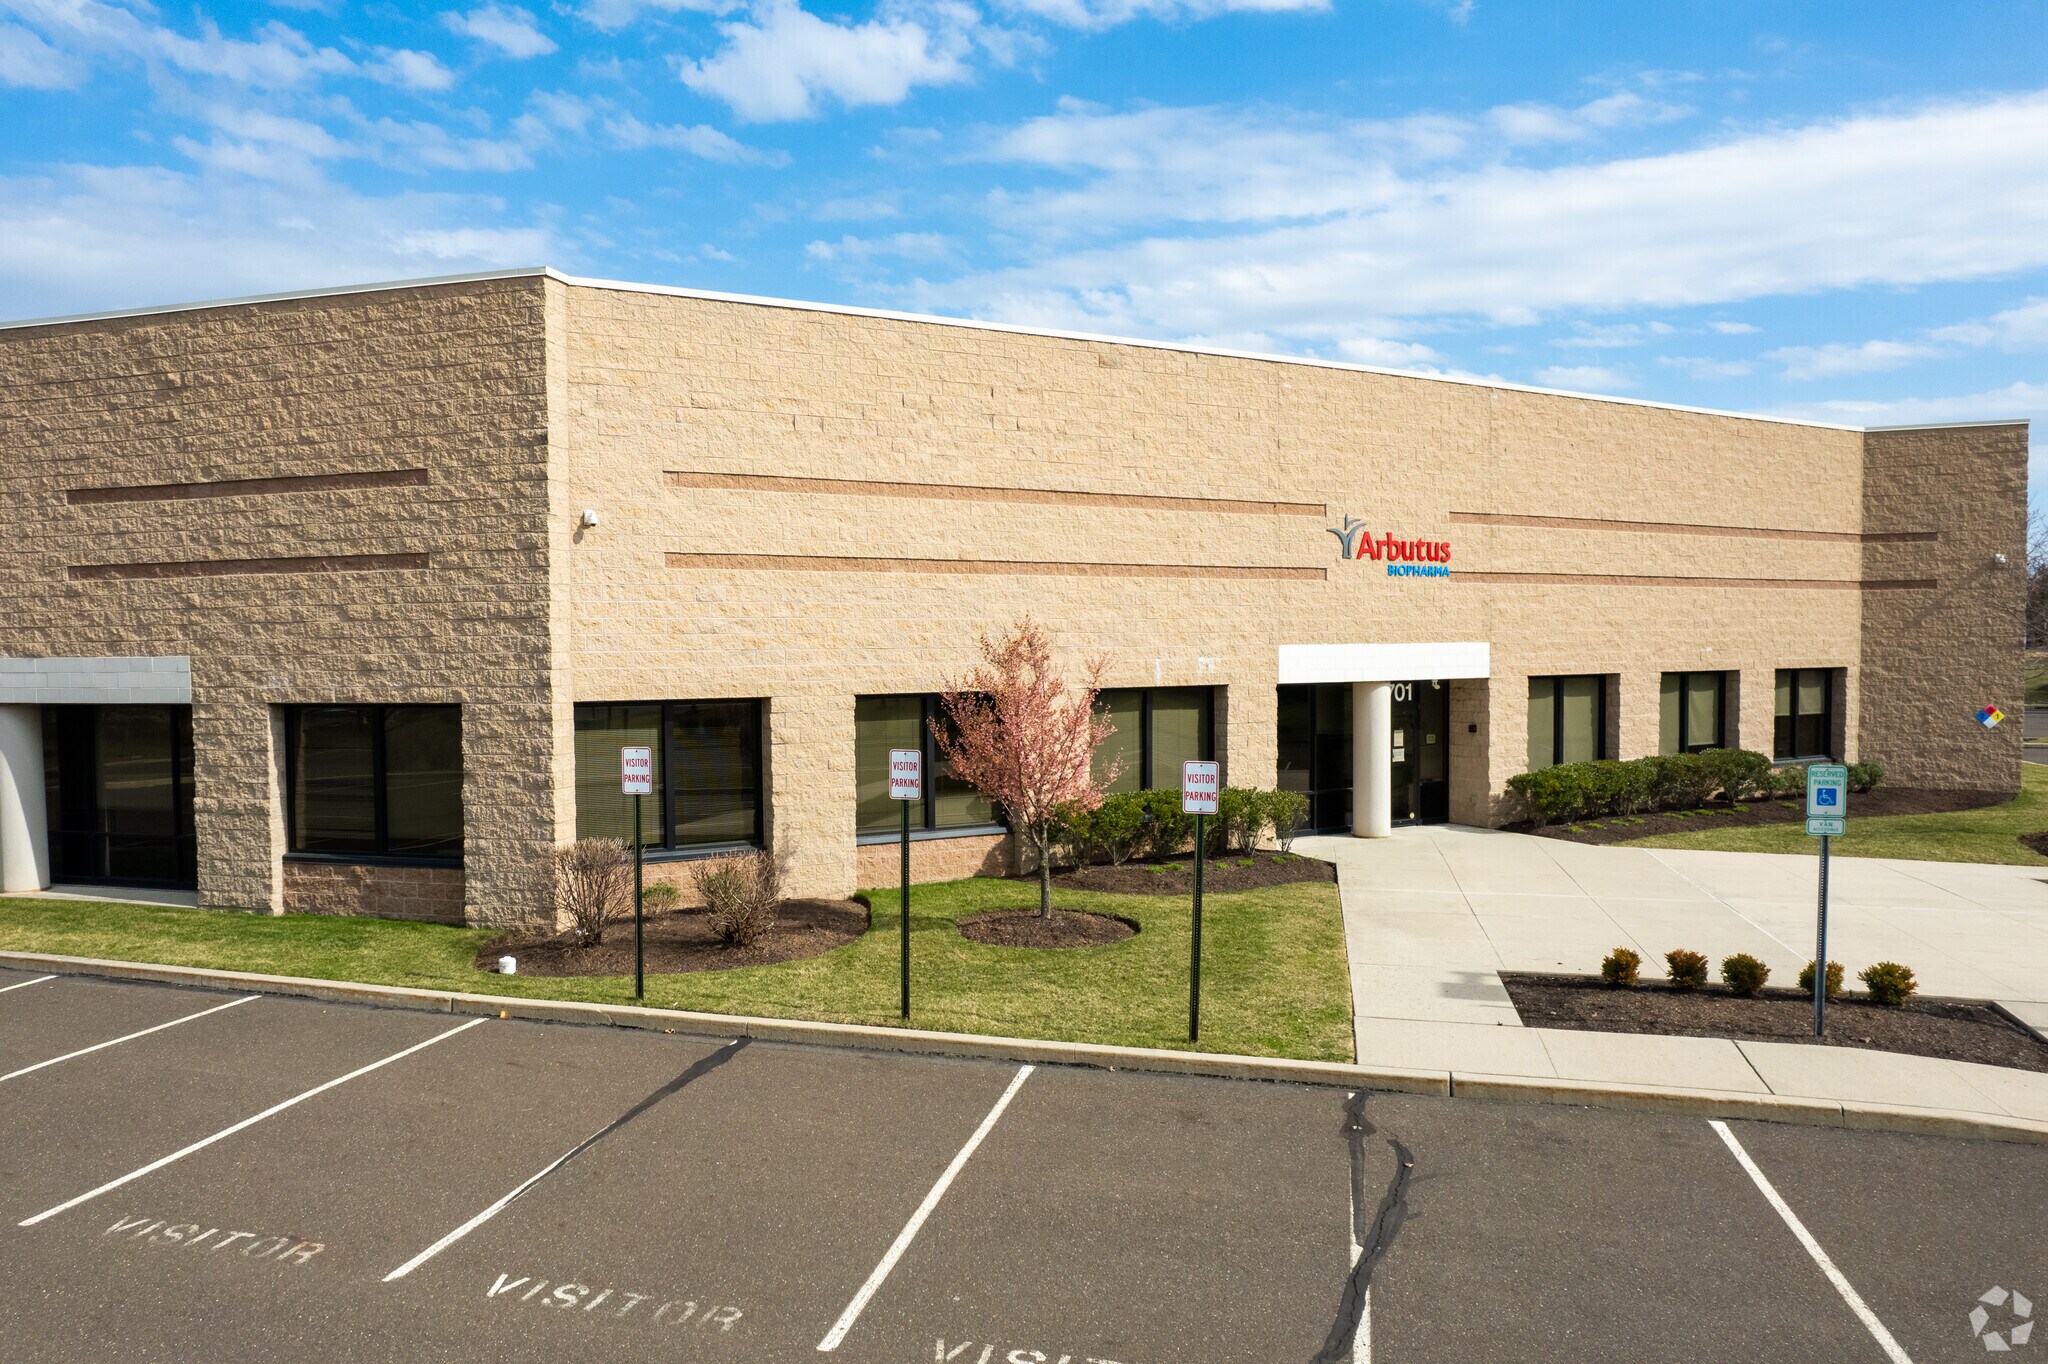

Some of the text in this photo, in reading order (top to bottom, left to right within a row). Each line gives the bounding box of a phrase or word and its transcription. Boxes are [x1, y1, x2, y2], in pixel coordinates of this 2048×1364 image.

[1356, 531, 1450, 562] Arbutus
[1387, 564, 1450, 577] BIOPHARMA
[625, 758, 649, 767] VISITOR
[892, 761, 918, 771] VISITOR
[624, 774, 650, 783] PARKING
[891, 778, 919, 788] PARKING
[1187, 773, 1215, 784] VISITOR
[1185, 791, 1217, 801] PARKING
[102, 1216, 325, 1264] VISITOR
[486, 1273, 743, 1331] VISITOR
